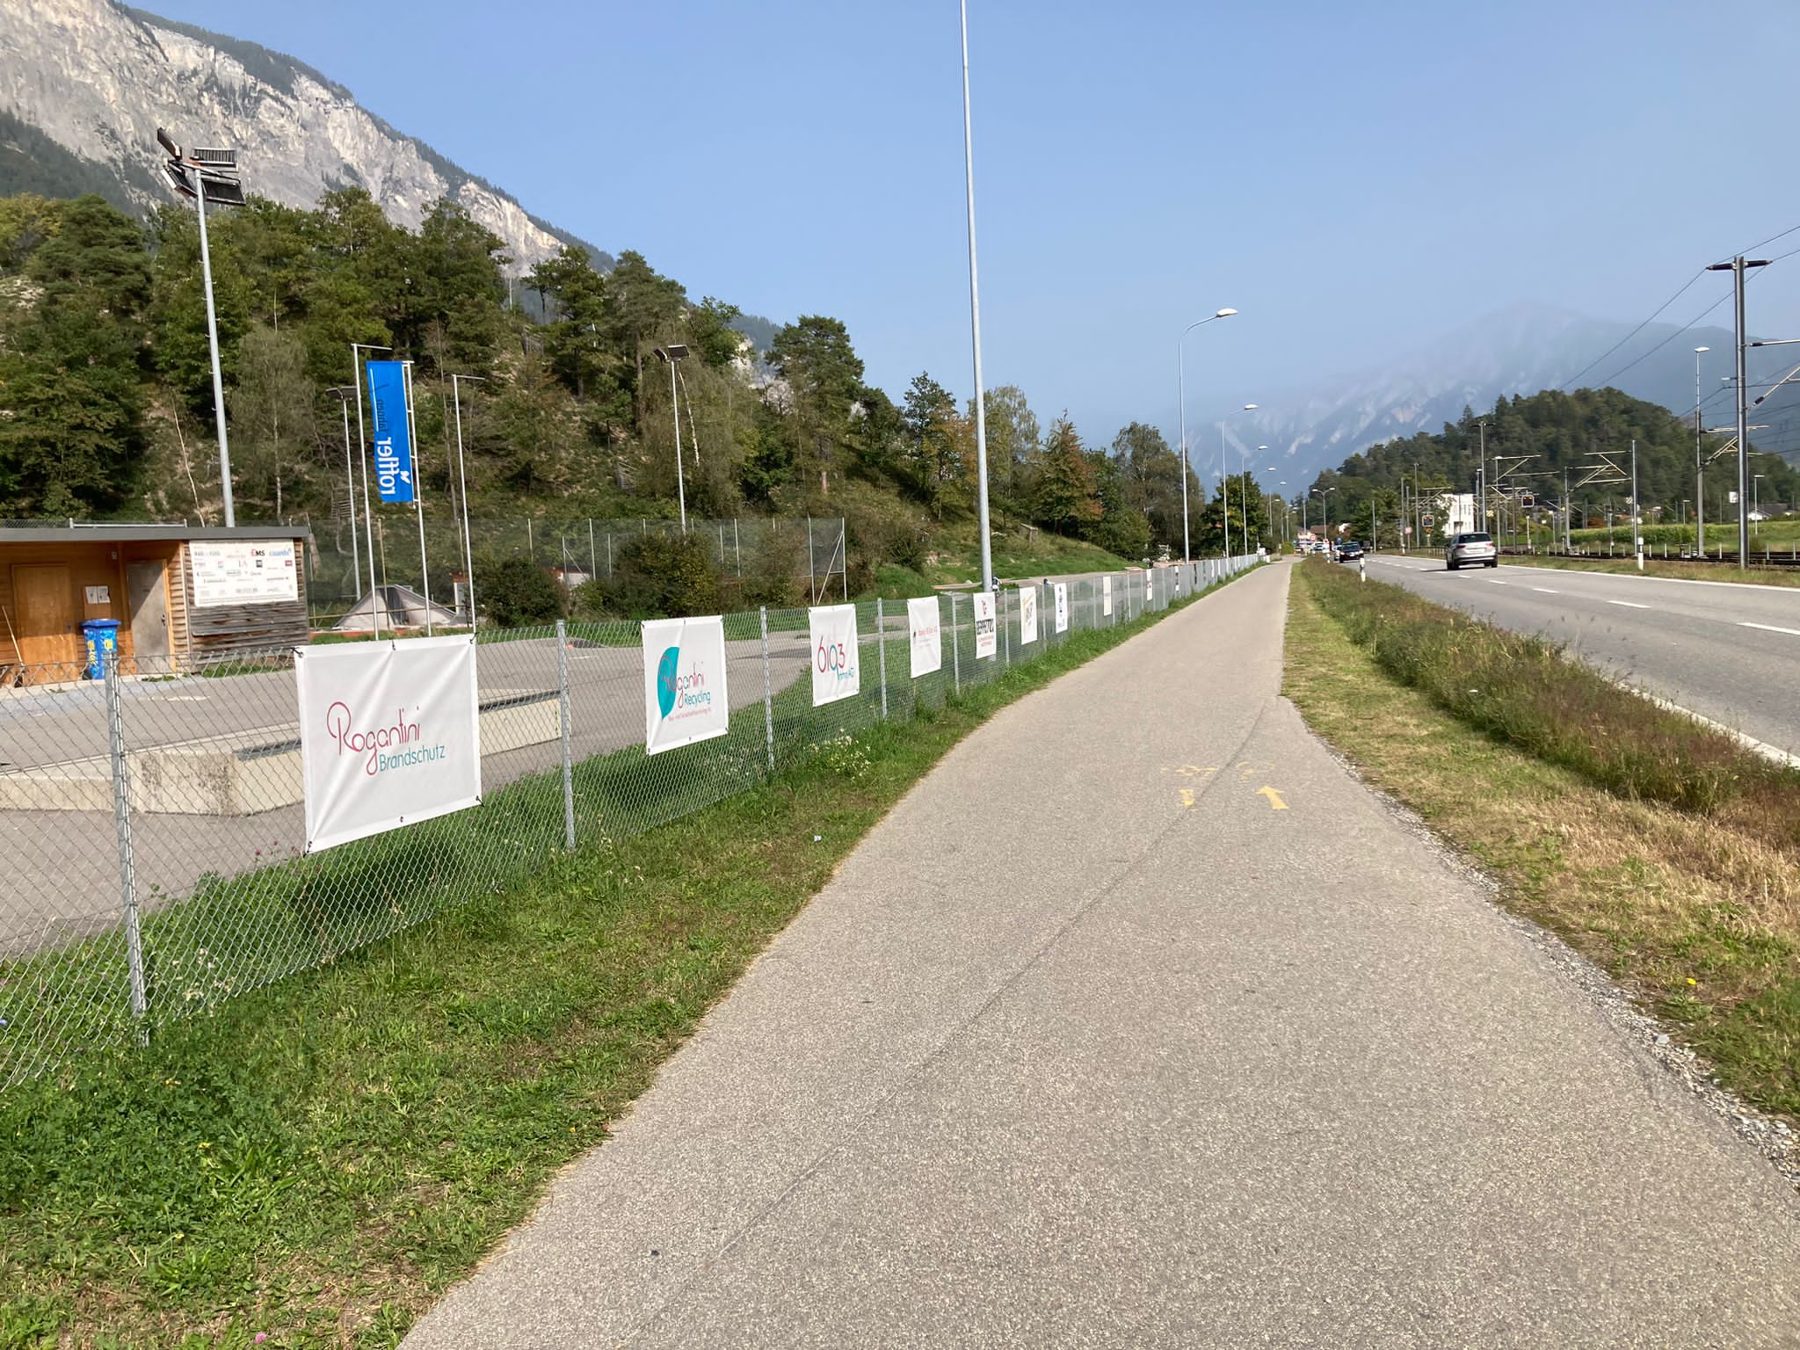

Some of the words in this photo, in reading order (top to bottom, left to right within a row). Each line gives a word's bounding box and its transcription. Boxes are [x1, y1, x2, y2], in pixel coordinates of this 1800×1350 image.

[684, 690, 711, 706] Recycling
[326, 701, 420, 775] Rogantini
[379, 744, 446, 772] Brandschutz
